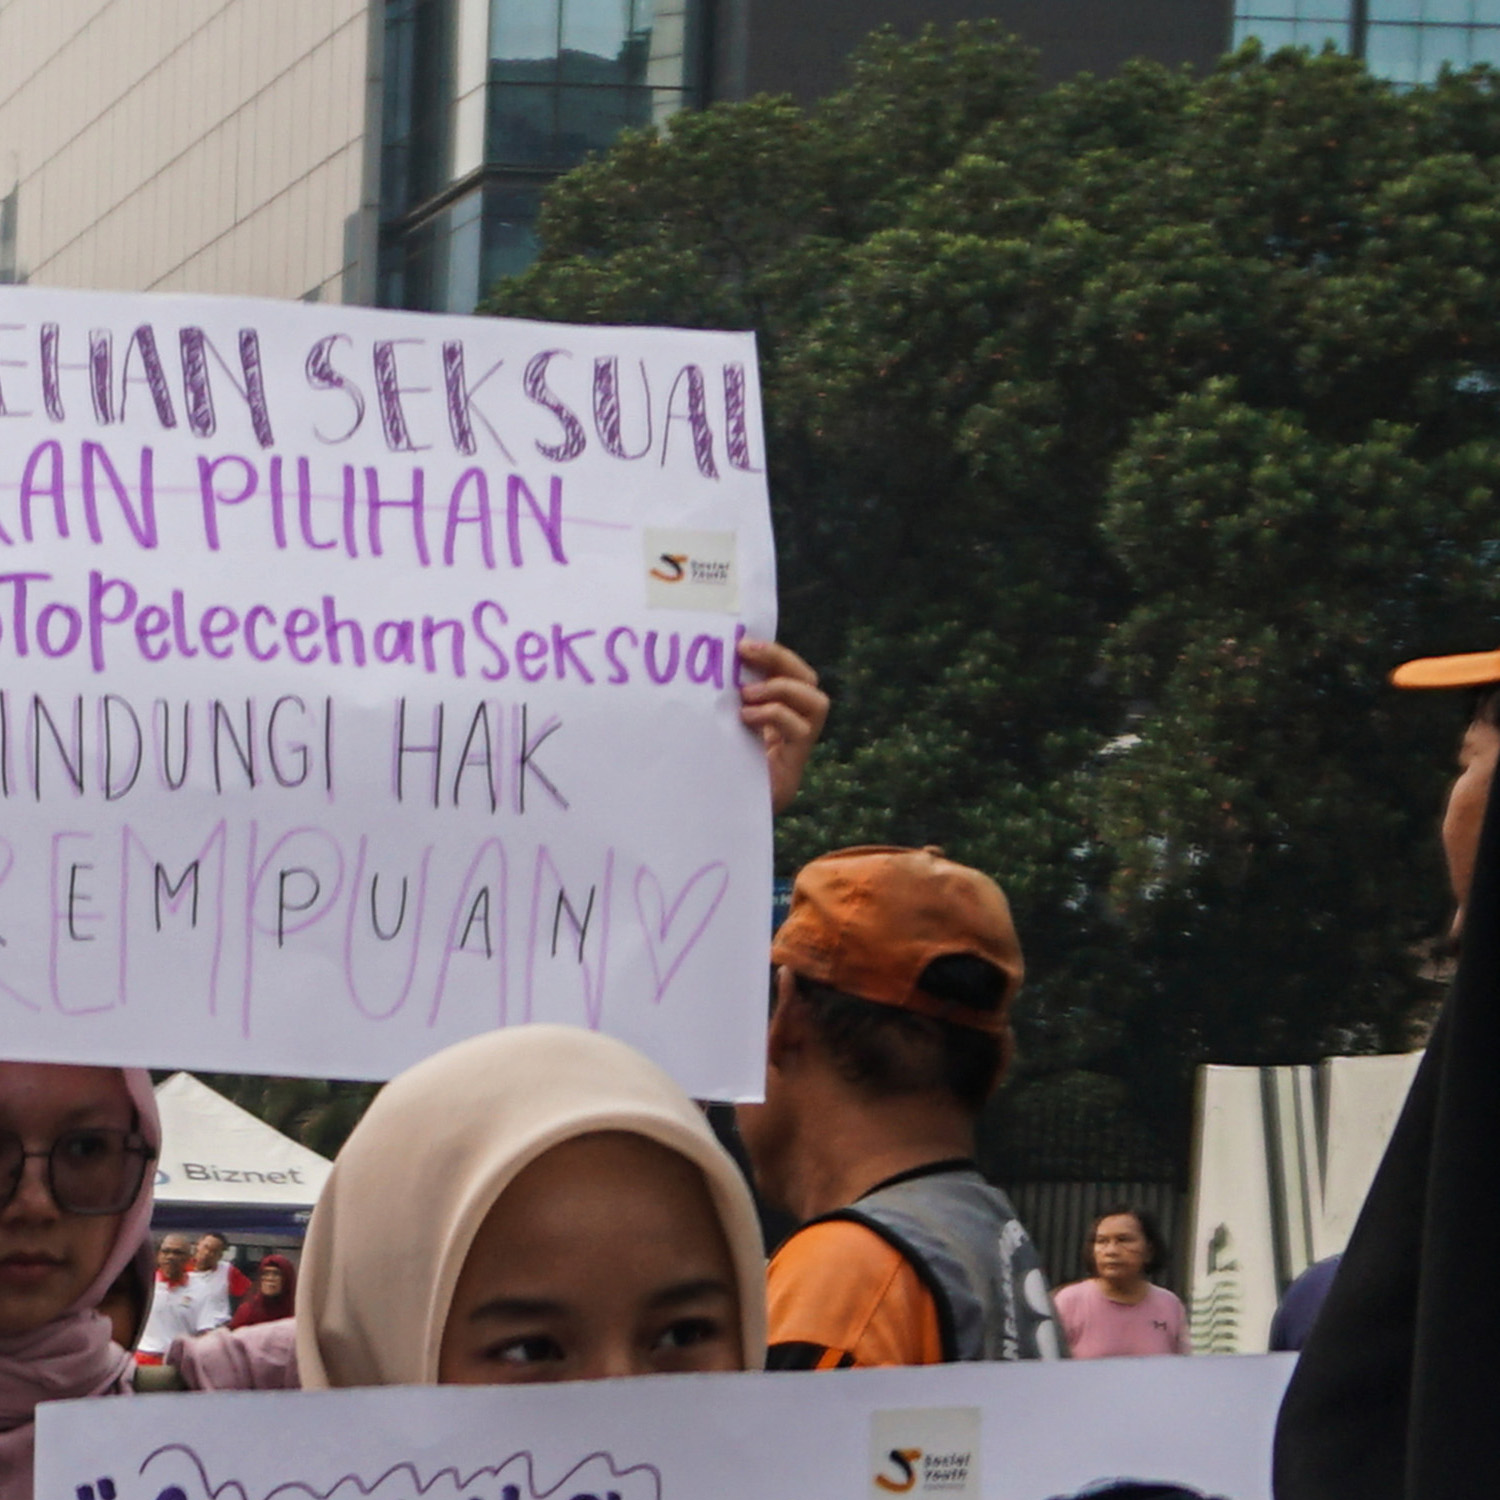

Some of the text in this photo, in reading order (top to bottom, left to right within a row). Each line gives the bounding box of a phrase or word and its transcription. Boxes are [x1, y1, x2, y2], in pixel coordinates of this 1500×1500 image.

[304, 332, 763, 481] SEKSUAL
[197, 454, 569, 570] PILIHAN
[392, 696, 571, 815] HAK
[183, 1163, 305, 1186] Biznet
